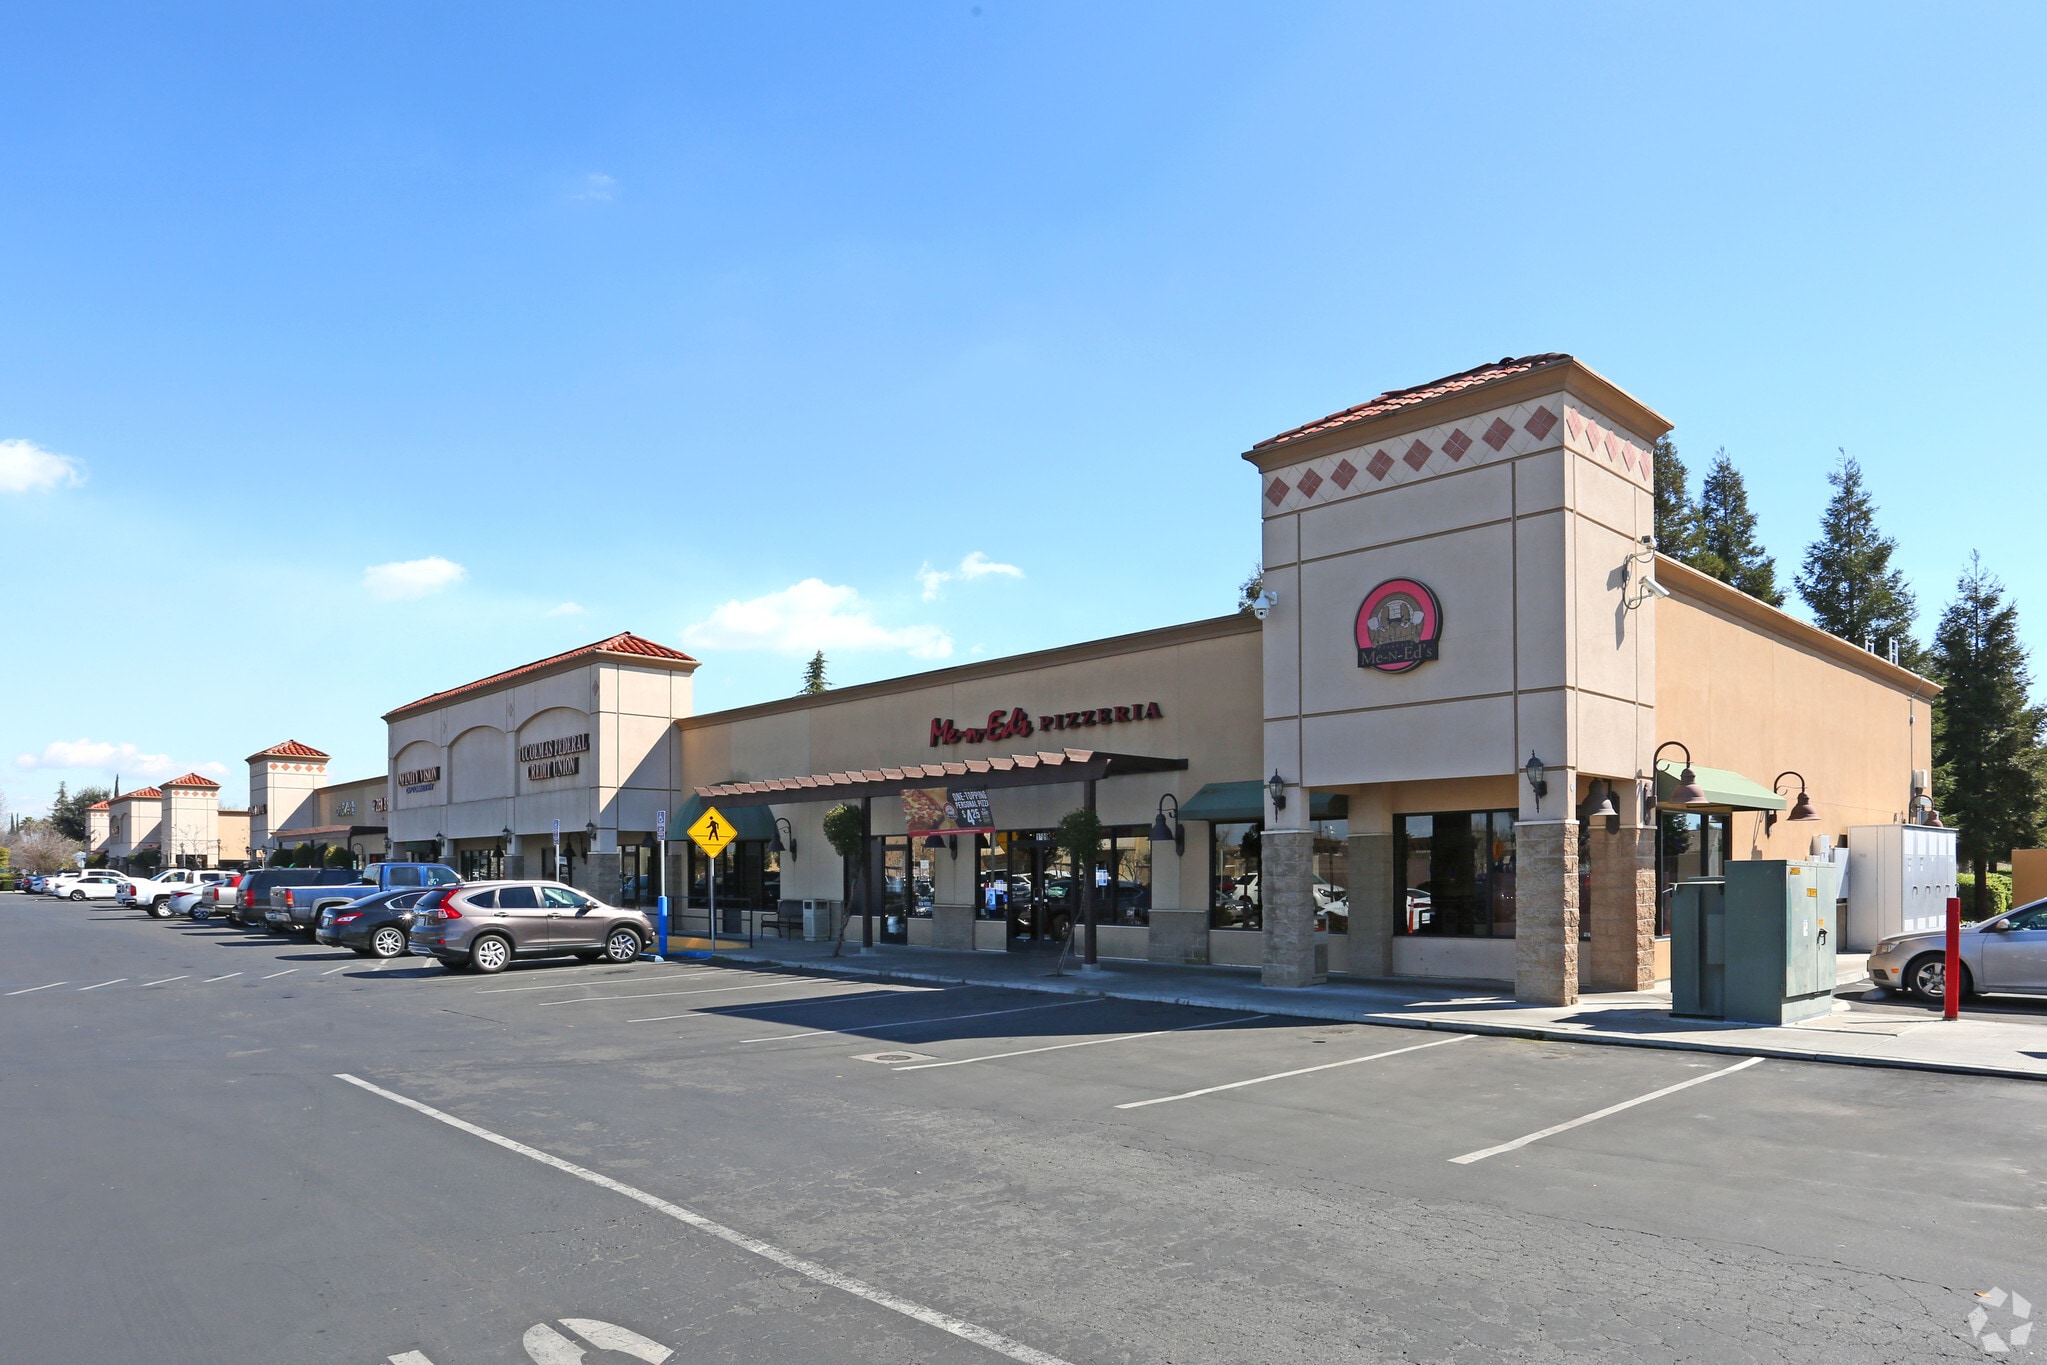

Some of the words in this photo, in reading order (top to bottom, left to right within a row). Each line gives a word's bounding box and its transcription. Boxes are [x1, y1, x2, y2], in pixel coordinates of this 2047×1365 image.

[1361, 643, 1433, 665] Me-N-Ed's
[929, 706, 1034, 747] Me-n-Ed's
[1038, 701, 1164, 732] PIZZERIA
[518, 740, 553, 762] TUCOEMAS
[554, 733, 590, 756] FEDERAL
[526, 760, 552, 781] CREDIT
[553, 757, 579, 777] UNION
[951, 790, 988, 802] ONE-TOPPING
[955, 801, 978, 809] PERSONAL
